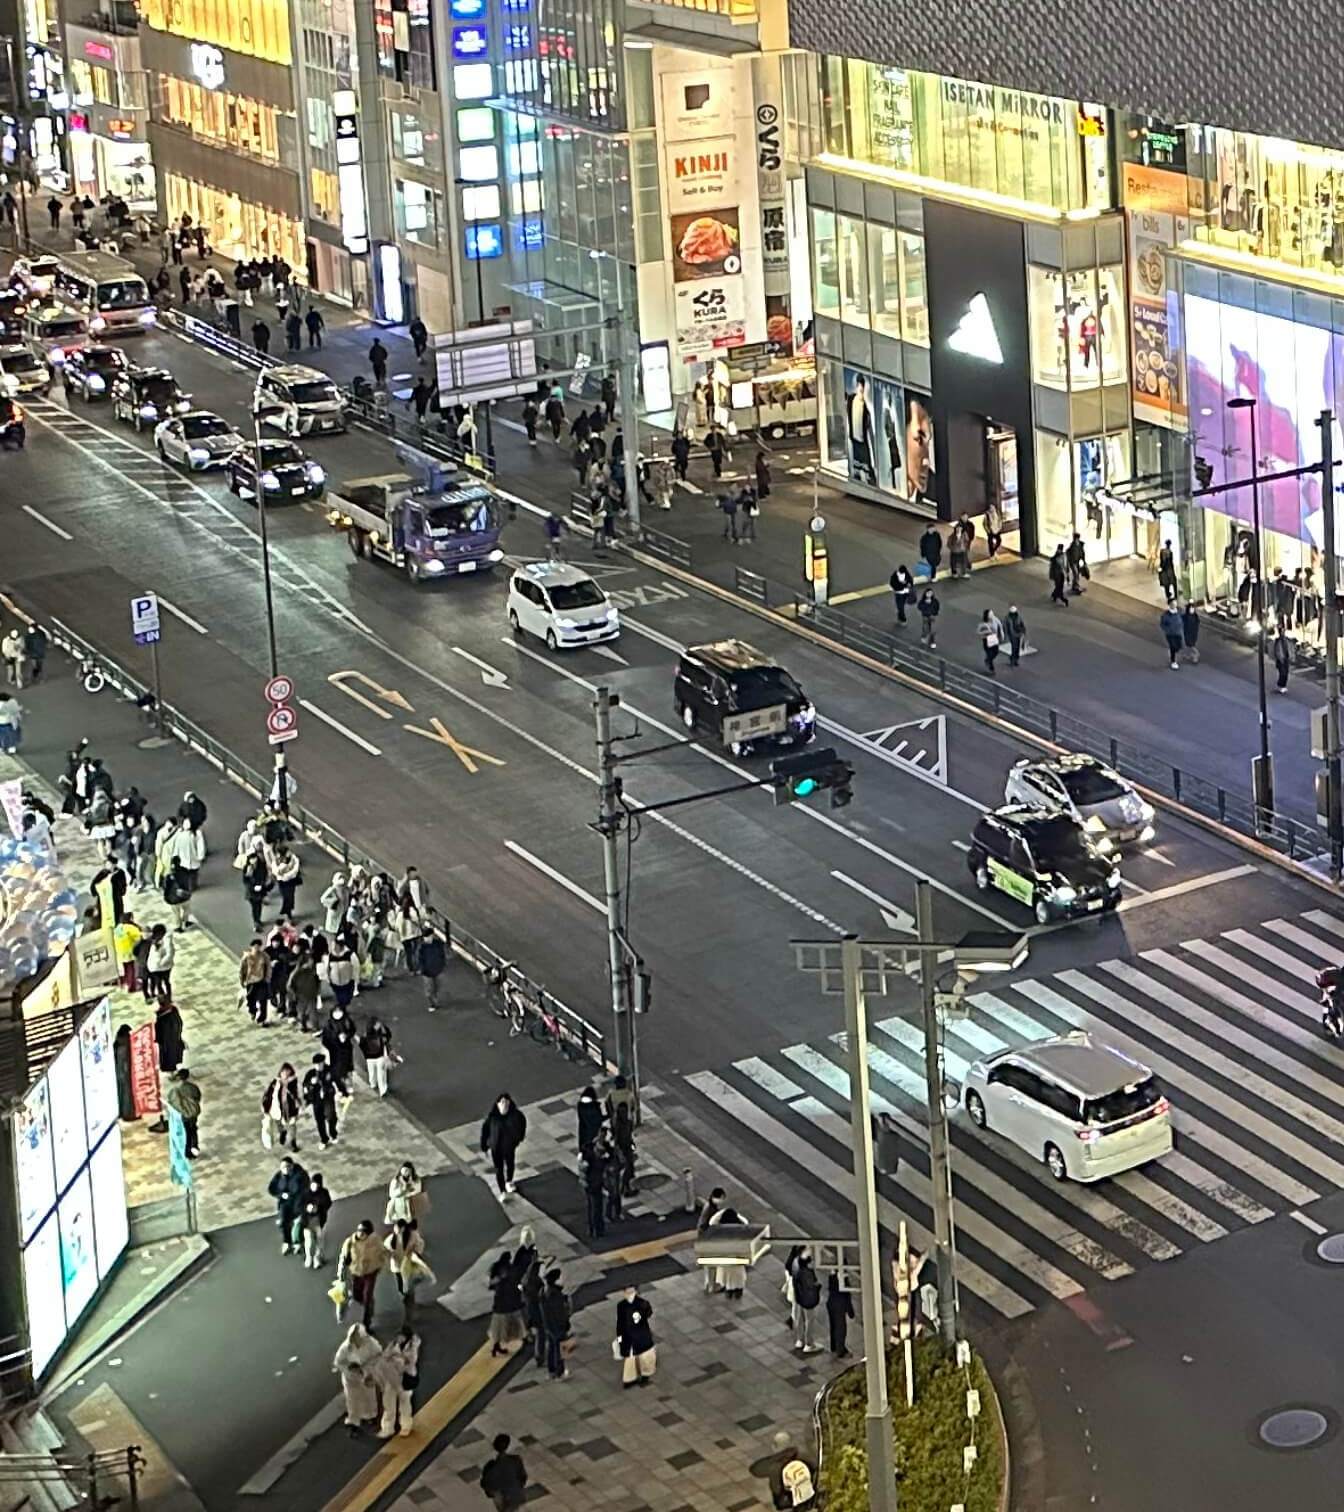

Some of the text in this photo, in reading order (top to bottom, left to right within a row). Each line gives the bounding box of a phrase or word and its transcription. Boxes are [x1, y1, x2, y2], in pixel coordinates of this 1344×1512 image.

[944, 82, 995, 109] ISETAN
[758, 125, 782, 170] くら
[675, 152, 727, 178] KINJI
[692, 288, 726, 307] くら
[693, 306, 727, 319] KURA
[137, 599, 152, 619] P
[146, 630, 160, 642] IN
[272, 683, 287, 696] 50
